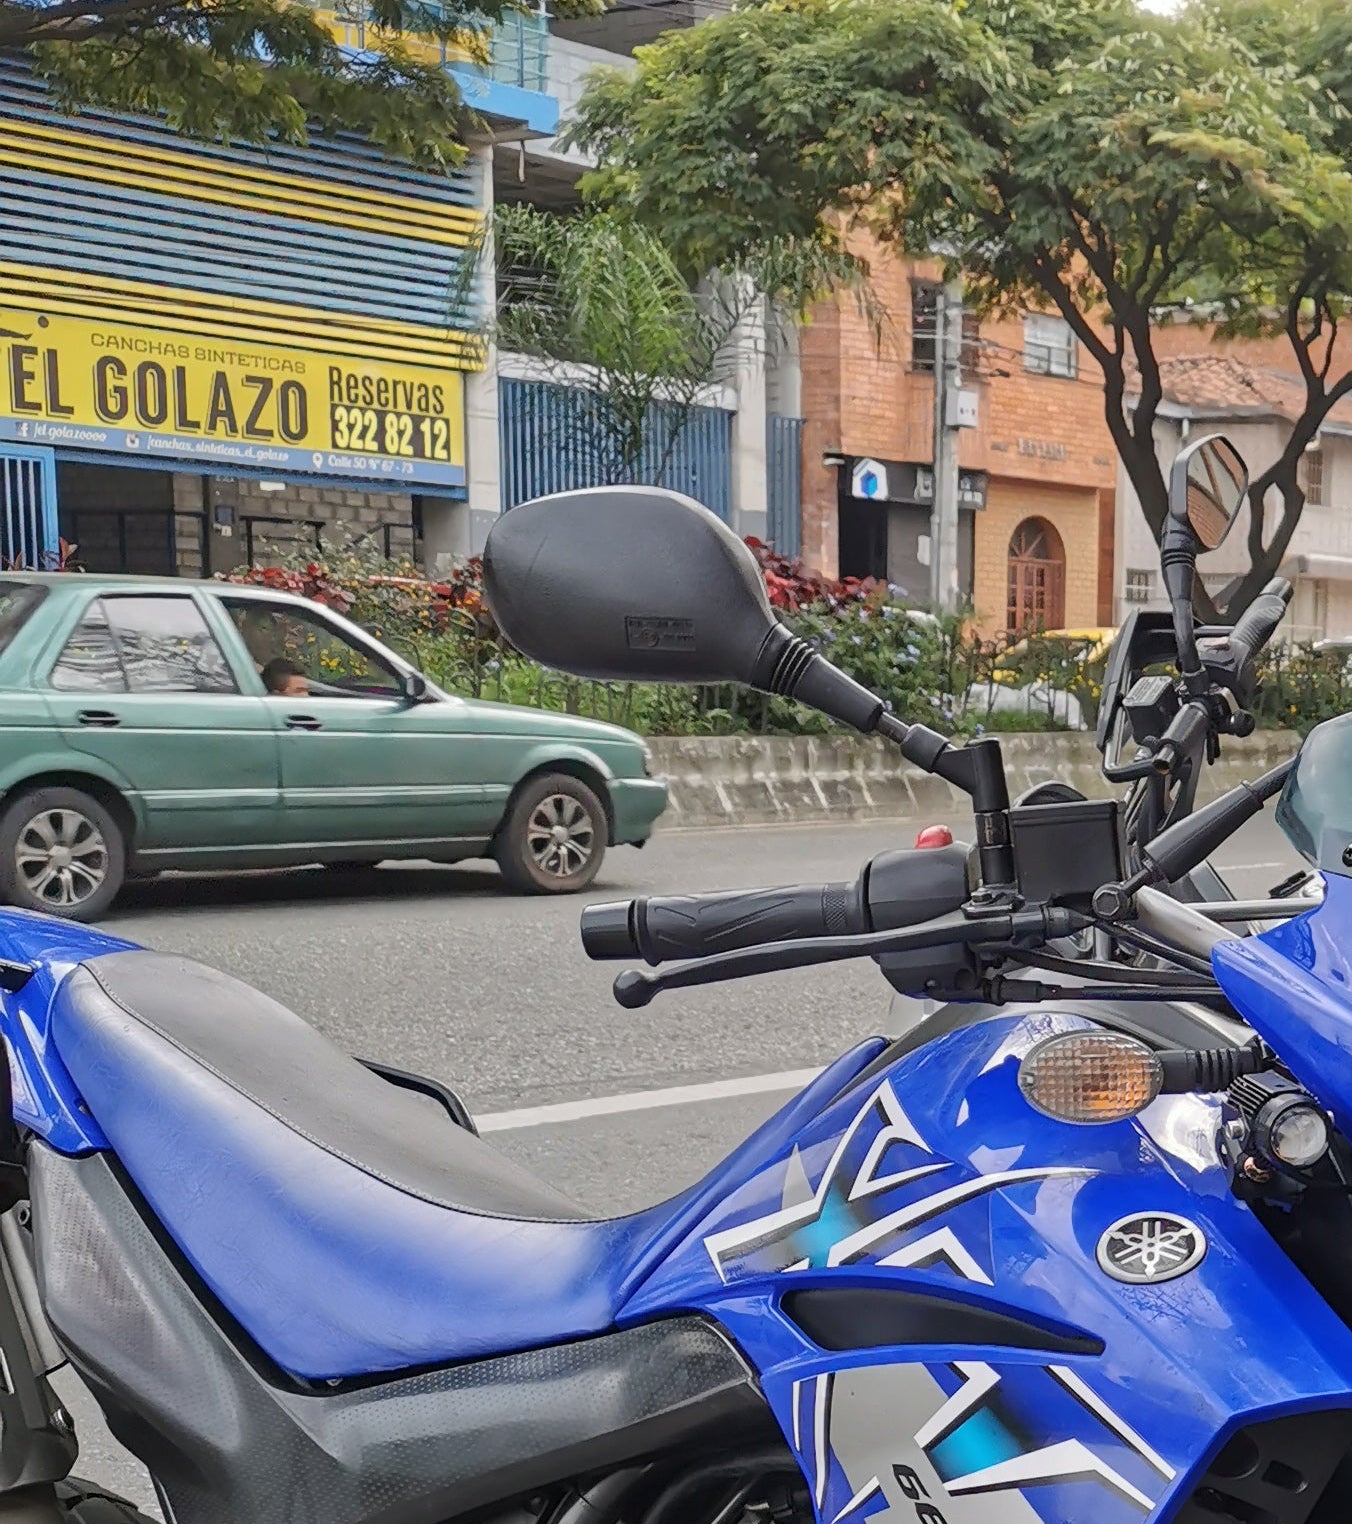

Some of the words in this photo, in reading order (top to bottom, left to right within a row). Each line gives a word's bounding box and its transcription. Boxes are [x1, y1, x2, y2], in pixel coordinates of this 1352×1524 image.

[90, 333, 190, 359] CANCHAS
[195, 346, 307, 374] SINTETICAS
[8, 343, 74, 417] EL
[92, 355, 309, 445] GOLAZO
[328, 366, 445, 414] Reservas
[335, 406, 378, 452] 322
[385, 412, 414, 456] 82
[420, 417, 448, 460] 12
